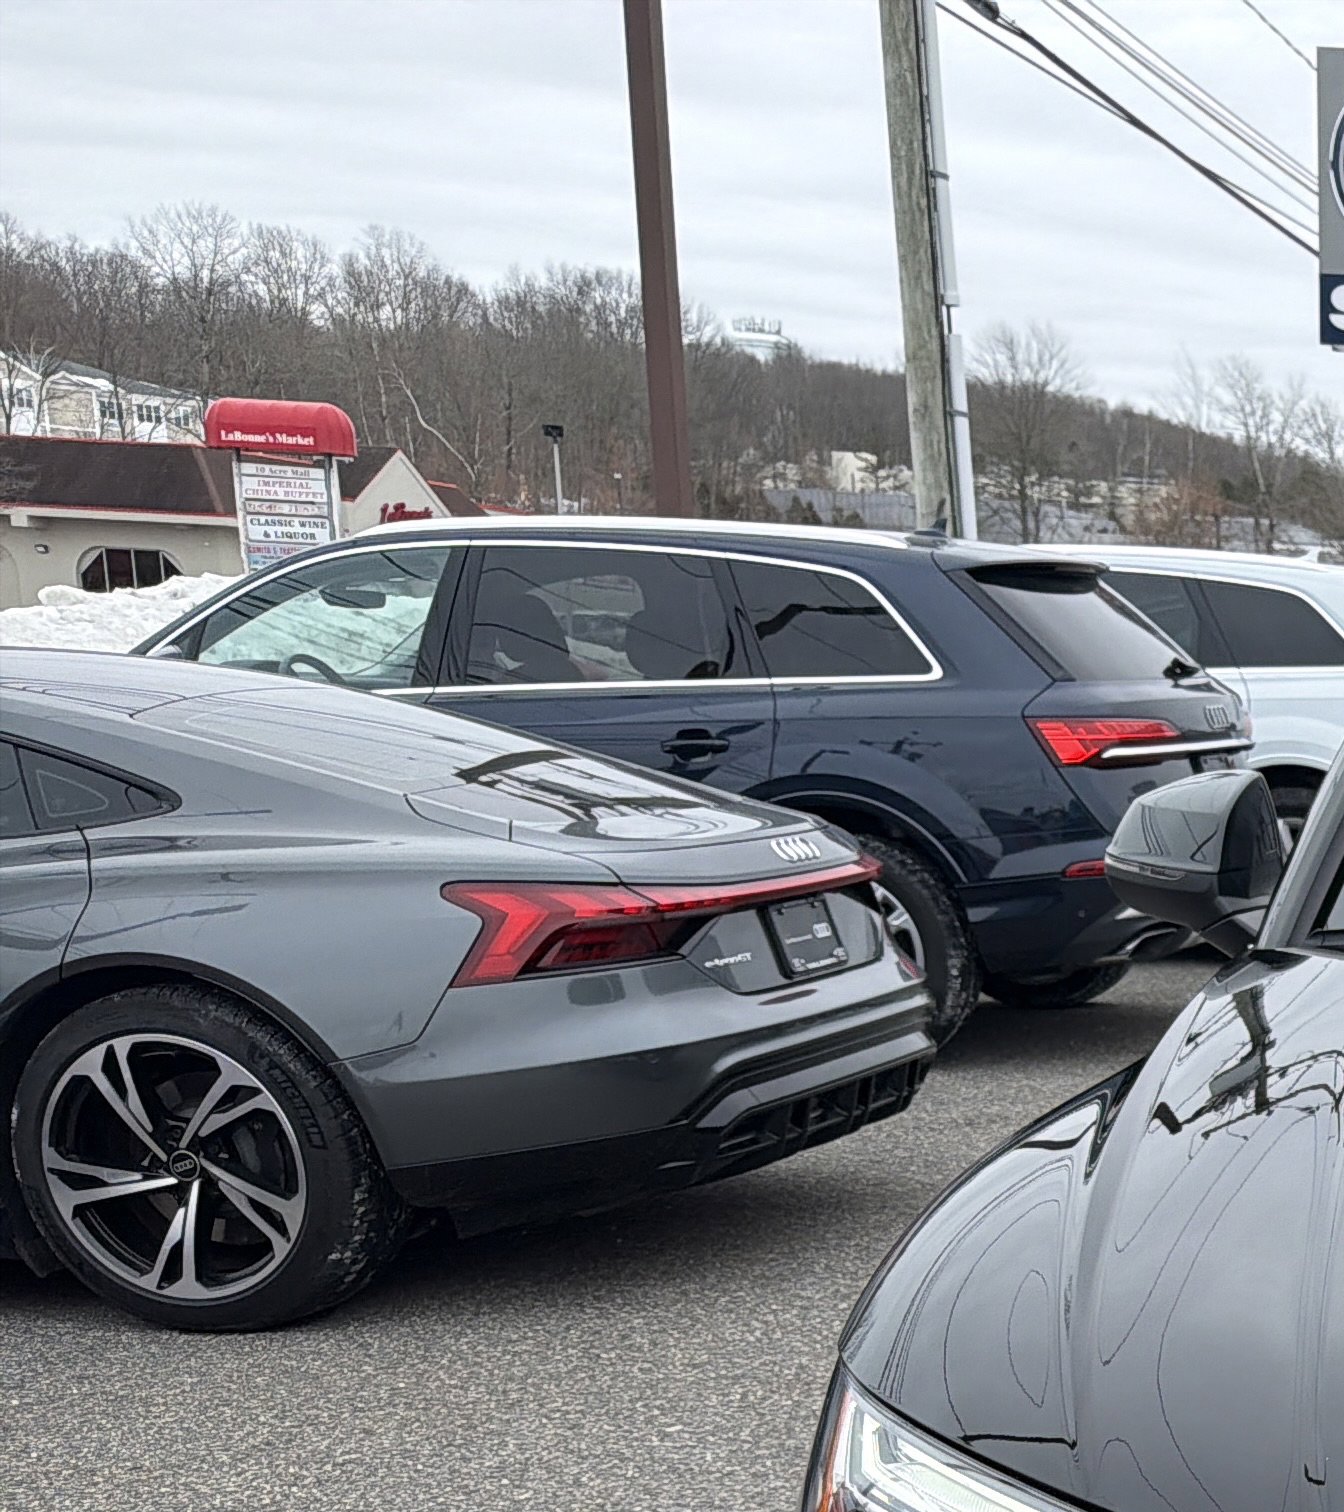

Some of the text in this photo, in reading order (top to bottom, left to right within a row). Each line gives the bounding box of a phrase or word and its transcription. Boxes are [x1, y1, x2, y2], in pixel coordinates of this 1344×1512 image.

[220, 429, 315, 446] LaBonne's Market
[255, 465, 311, 477] 10 Acre Mall
[257, 479, 312, 490] IMPERIAL
[244, 488, 325, 500] CHINA BUFFET
[249, 517, 328, 530] CLASSIC WINE
[262, 530, 317, 541] & LIQUOR
